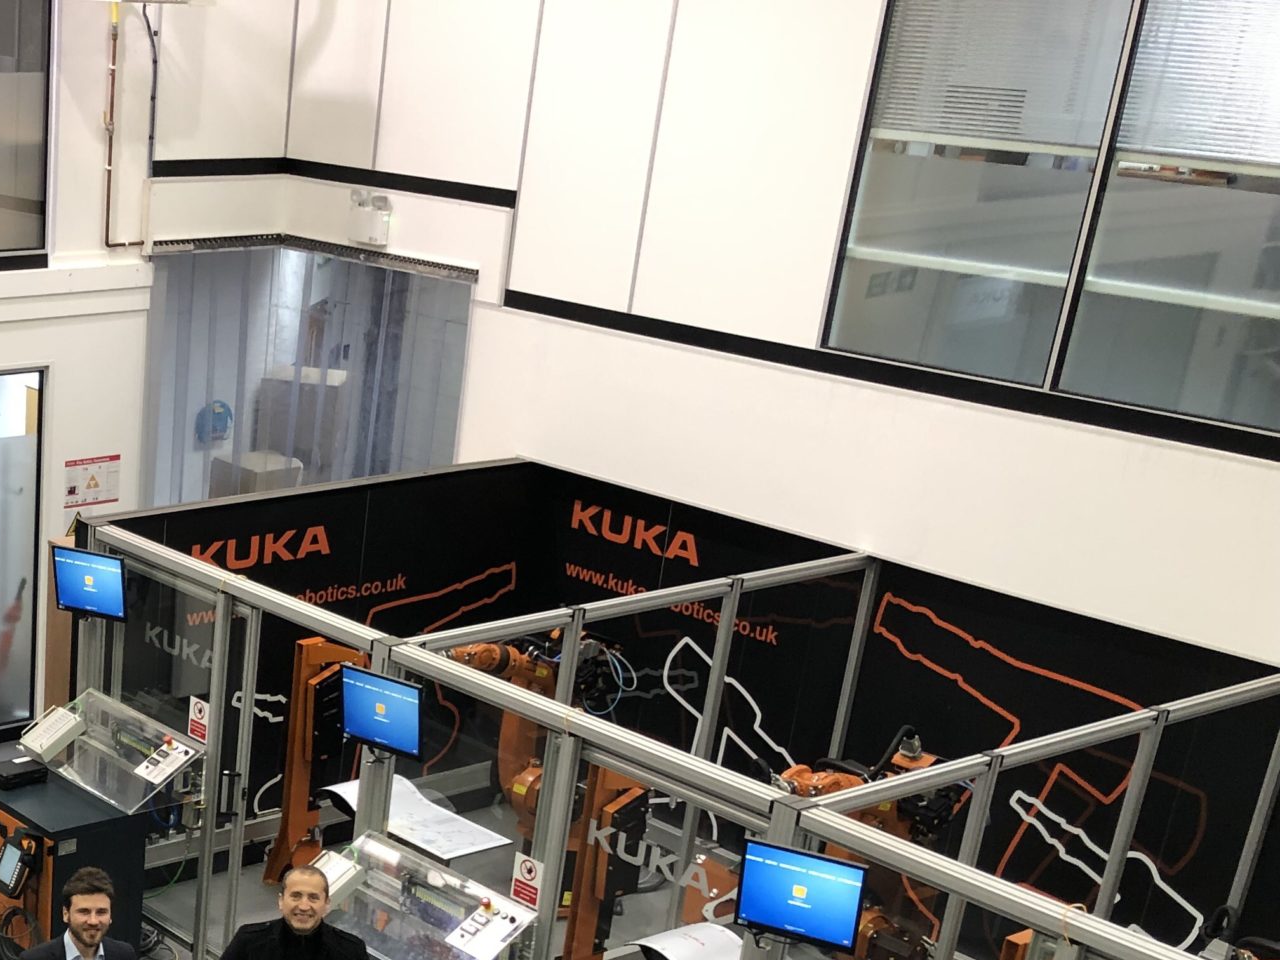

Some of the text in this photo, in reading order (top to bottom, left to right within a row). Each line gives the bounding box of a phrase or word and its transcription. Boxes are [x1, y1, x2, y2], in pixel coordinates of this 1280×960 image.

[191, 525, 330, 570] KUKA
[571, 500, 699, 567] KUKA
[144, 621, 212, 669] KUKA
[587, 818, 710, 899] KUKA
